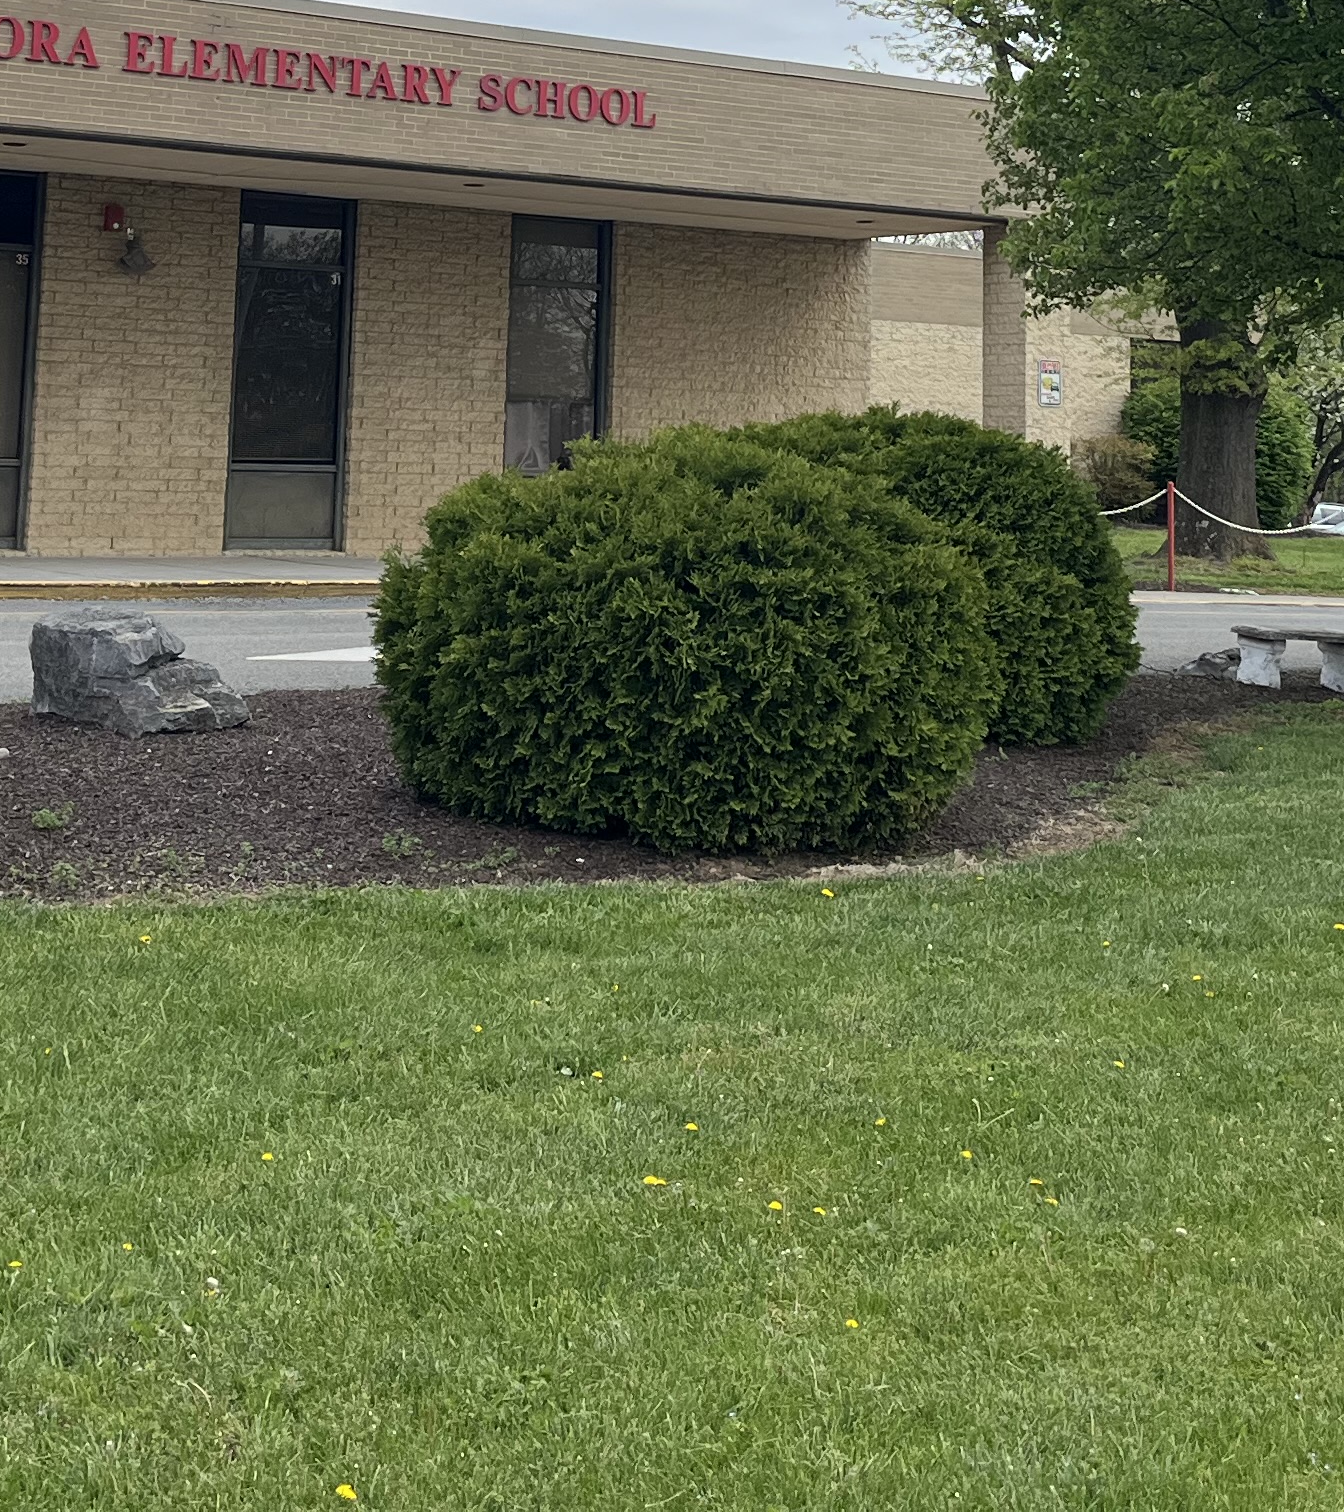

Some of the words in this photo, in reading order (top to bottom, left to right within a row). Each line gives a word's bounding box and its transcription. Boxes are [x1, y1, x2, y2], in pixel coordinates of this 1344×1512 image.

[123, 31, 462, 105] ELEMENTARY
[478, 74, 657, 128] SCHOOL
[16, 253, 29, 265] 35
[331, 272, 341, 285] 31
